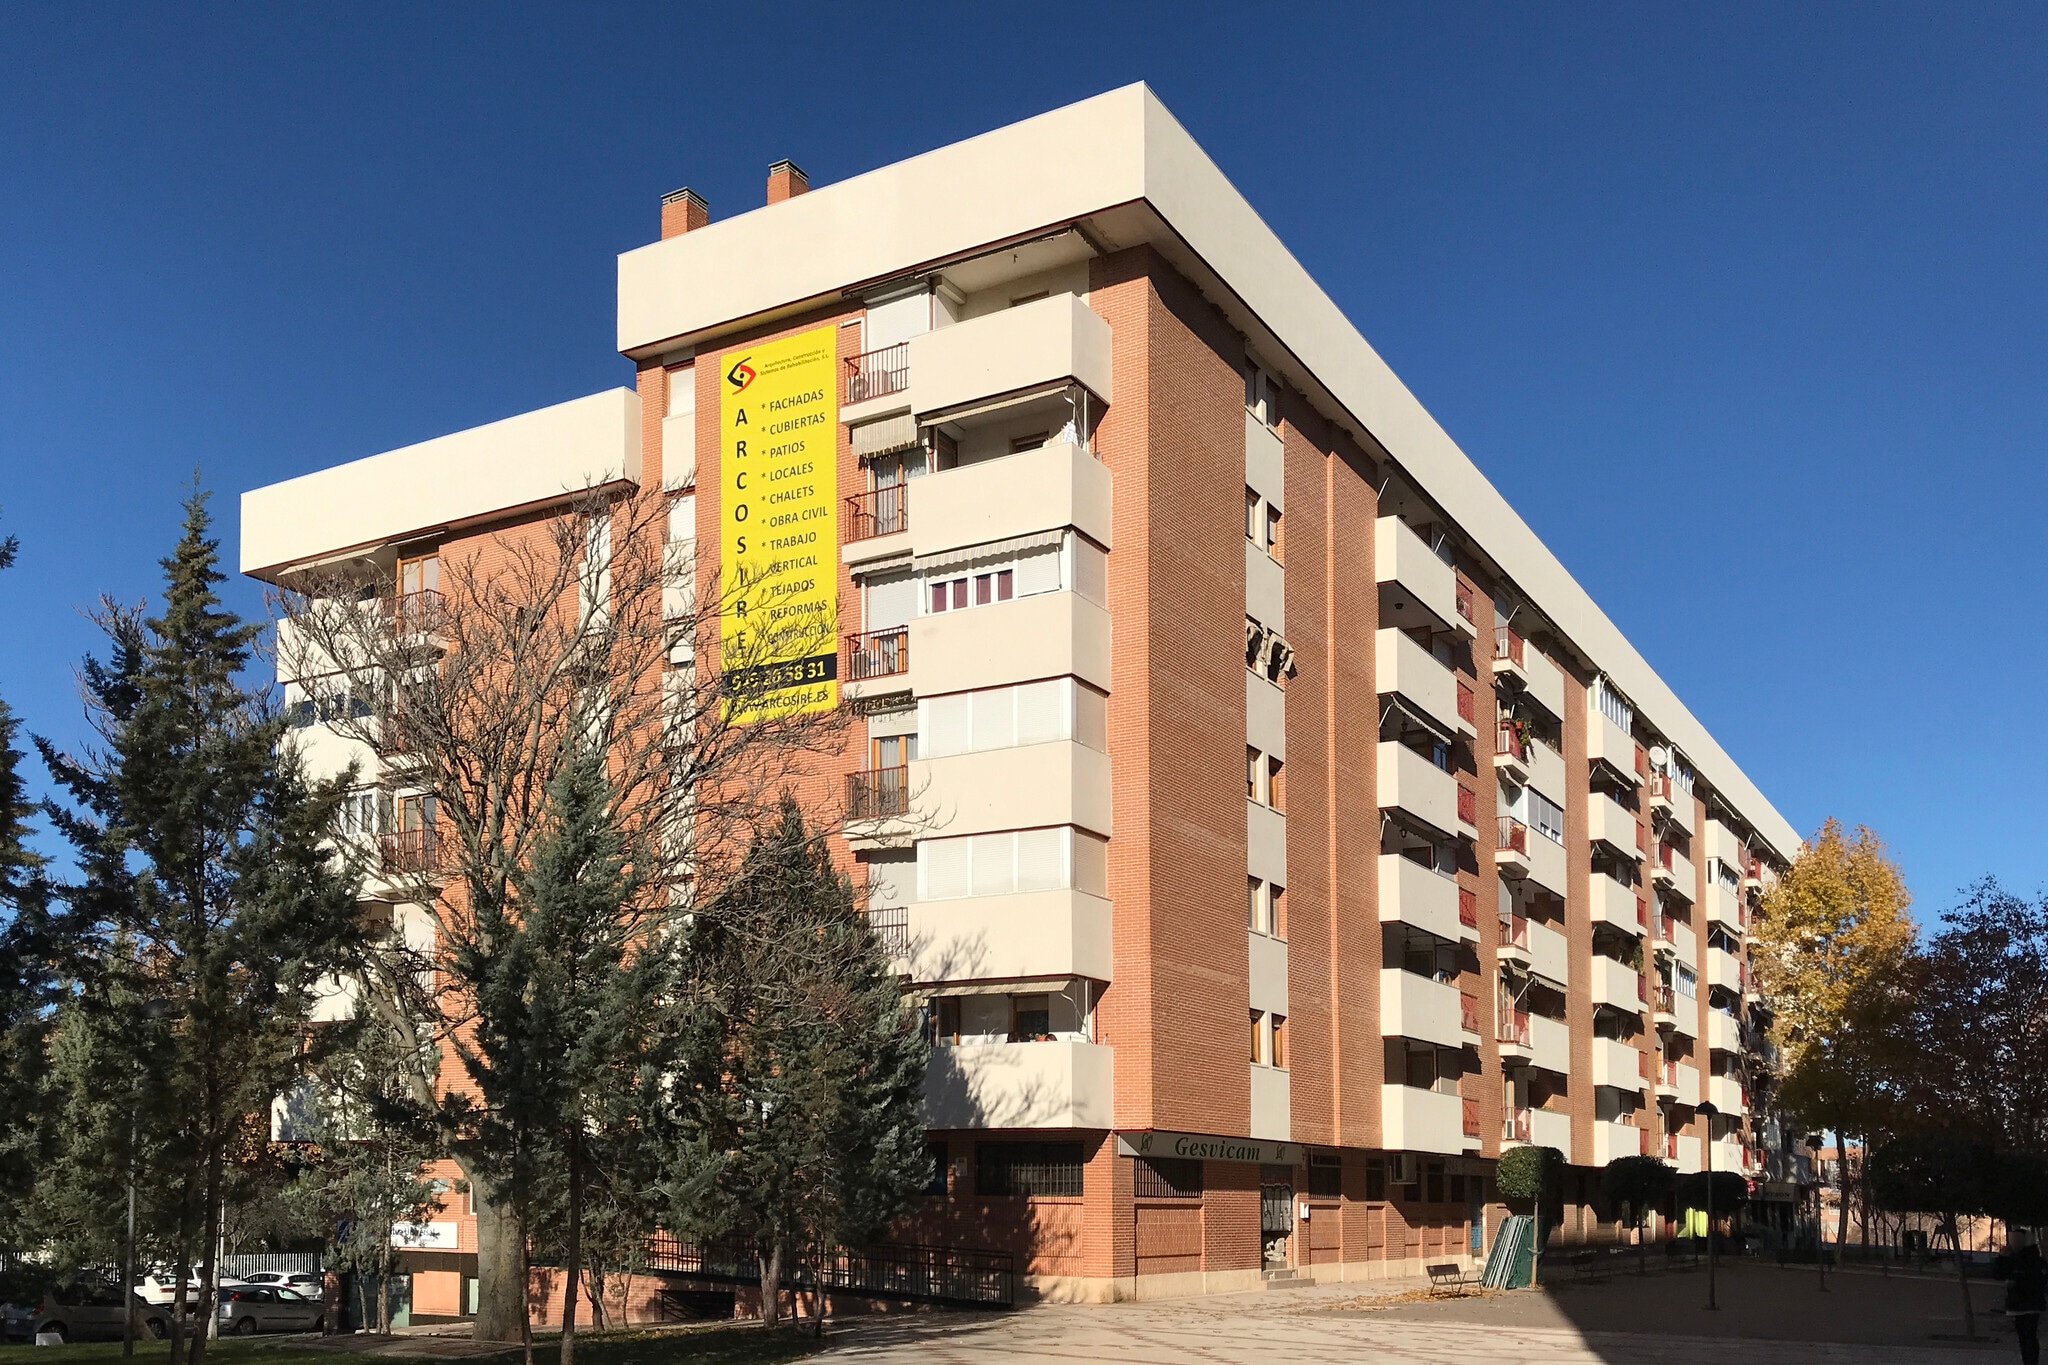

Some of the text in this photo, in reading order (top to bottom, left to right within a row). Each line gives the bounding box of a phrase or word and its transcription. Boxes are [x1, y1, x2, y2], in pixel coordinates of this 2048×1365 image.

[769, 389, 824, 412] FACHADAS
[769, 412, 826, 435] CUBIERTAS
[770, 441, 805, 458] PATIOS
[769, 462, 814, 482] LOCALES
[769, 485, 815, 505] CHALETS
[769, 506, 828, 528] OBRA CIVIL
[770, 532, 817, 551] TRABAJO
[769, 555, 818, 573] VERTICAL
[770, 579, 815, 598] TEJADOS
[770, 600, 828, 620] REFORMAS
[807, 660, 826, 679] 31
[1175, 1136, 1261, 1161] Gesvicam
